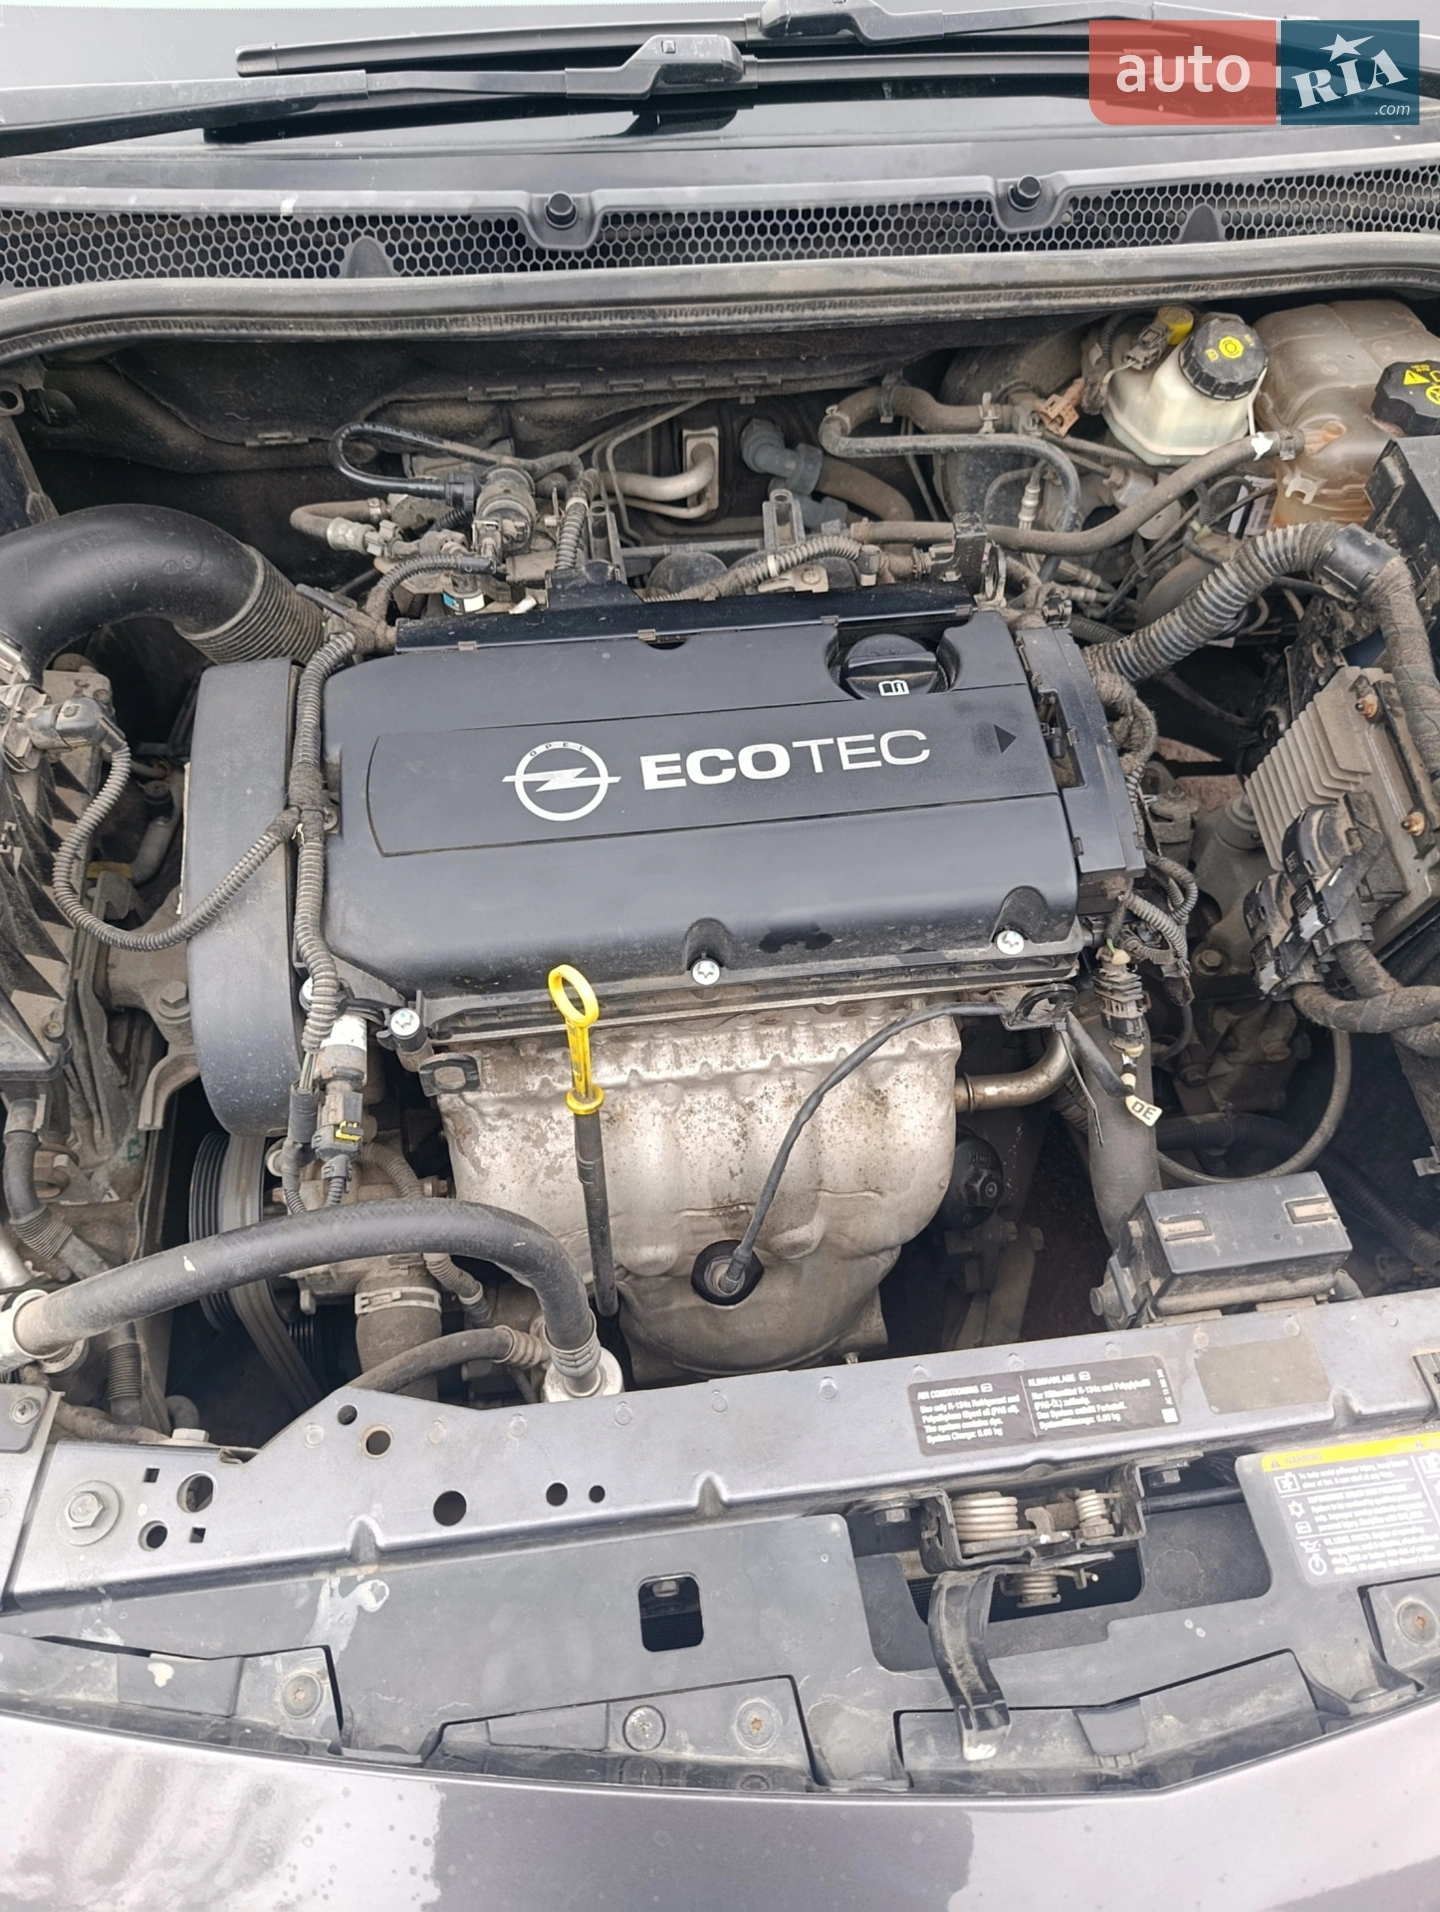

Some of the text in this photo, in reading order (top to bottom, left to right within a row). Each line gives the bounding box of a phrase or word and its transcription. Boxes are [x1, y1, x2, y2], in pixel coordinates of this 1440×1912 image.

[529, 742, 584, 757] OPEL
[640, 729, 930, 790] ECOTEC
[1131, 1101, 1157, 1121] DE
[1028, 1374, 1076, 1386] KLIMAANLAGE
[918, 1386, 979, 1400] AIR CONDITIONING
[924, 1425, 937, 1433] The
[926, 1434, 951, 1444] System
[993, 1428, 1003, 1436] kg
[1283, 1451, 1322, 1465] WARNING
